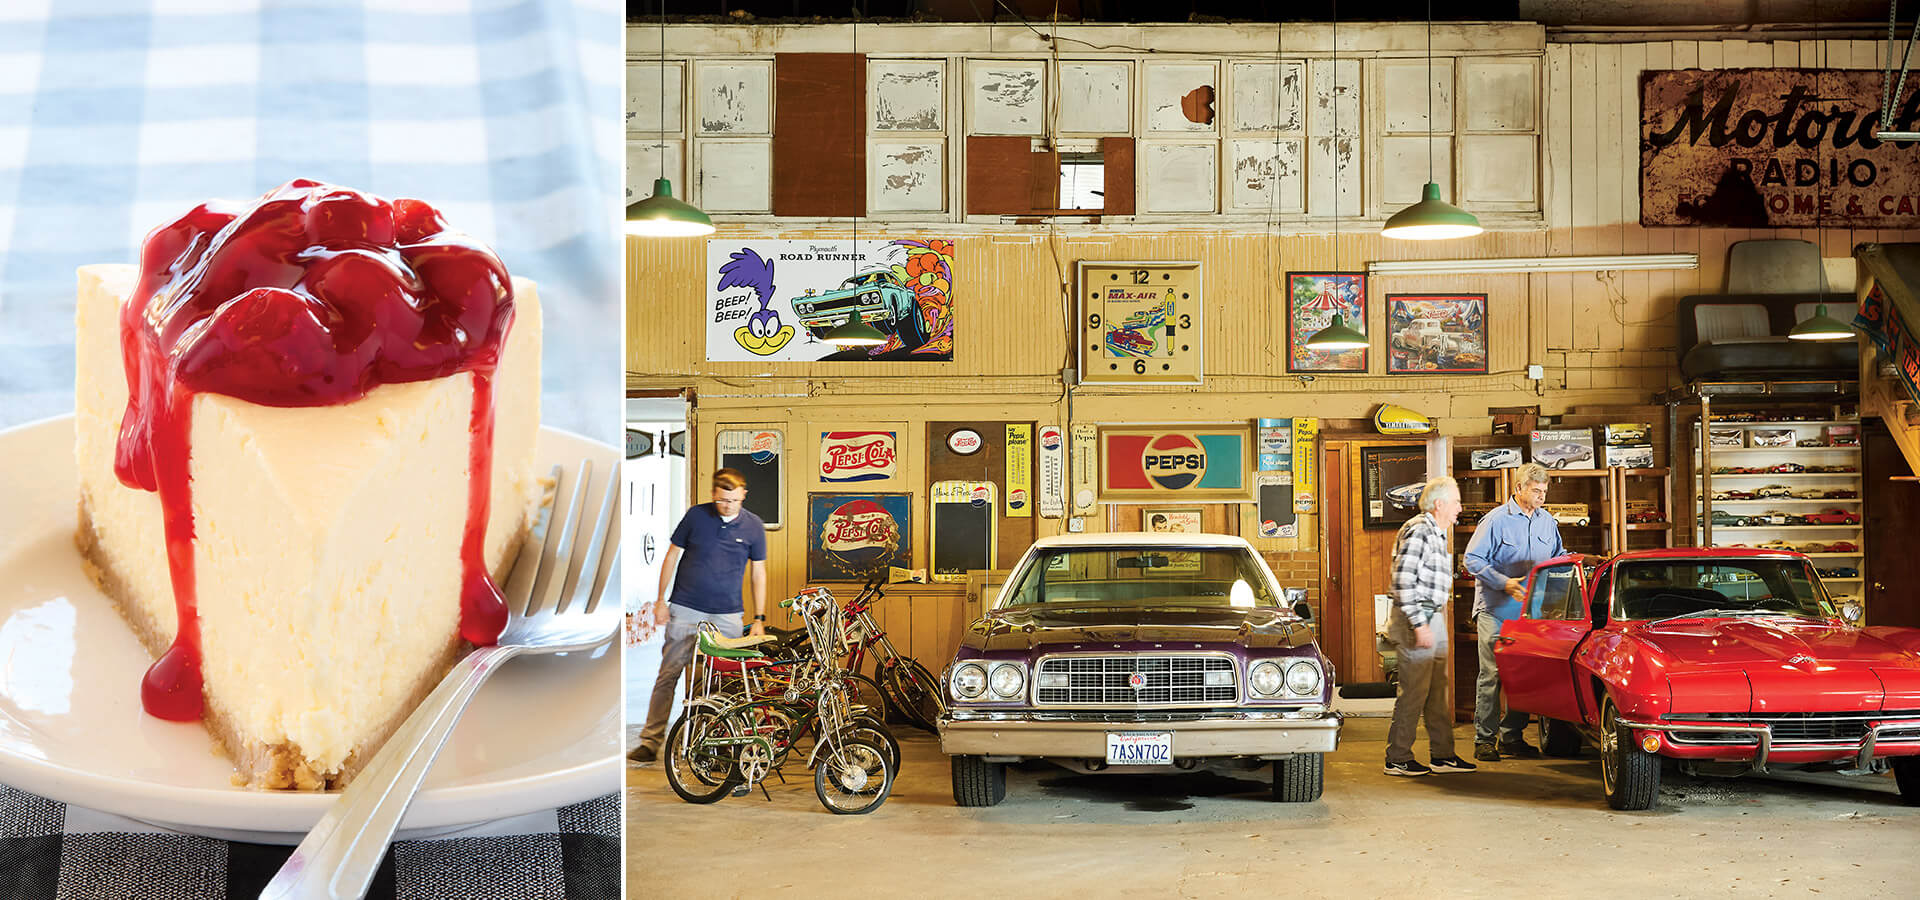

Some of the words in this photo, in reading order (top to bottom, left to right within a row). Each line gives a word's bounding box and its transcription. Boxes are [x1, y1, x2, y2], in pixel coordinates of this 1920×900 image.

[1730, 157, 1877, 188] RADIO
[1847, 196, 1864, 215] &
[1878, 196, 1920, 215] CA
[809, 245, 838, 253] Plymouth
[780, 253, 813, 261] ROAD
[817, 253, 866, 261] RUNNER
[1129, 270, 1149, 285] 12
[715, 292, 752, 311] BEEP!
[714, 307, 753, 323] BEEP!
[1088, 313, 1101, 329] 9
[1179, 314, 1191, 329] 3
[1134, 359, 1146, 374] 6
[1075, 434, 1096, 442] Pepsi
[1145, 454, 1205, 470] PEPSI
[1120, 735, 1160, 744] California
[1111, 744, 1168, 760] 7ASN702
